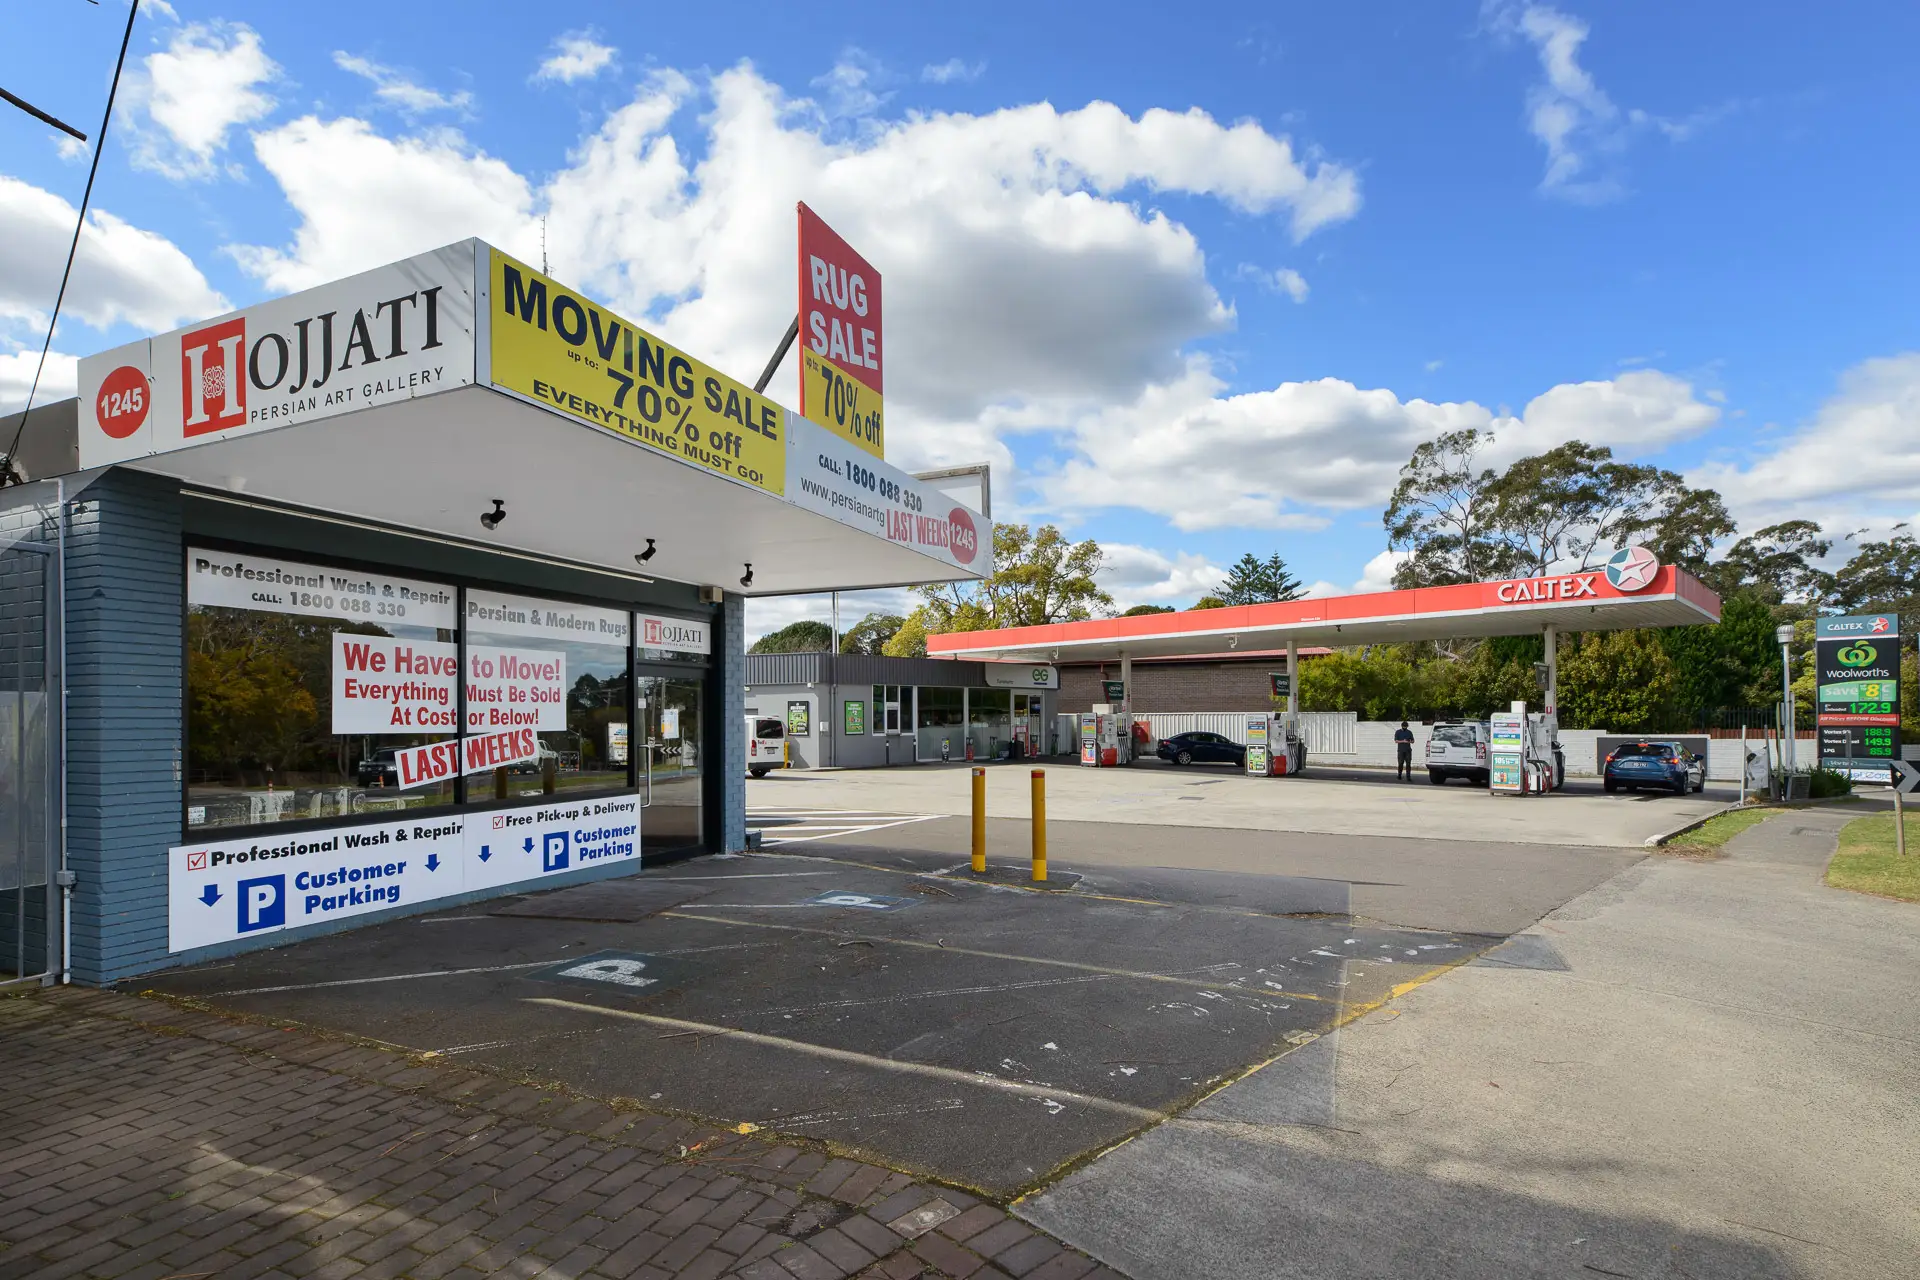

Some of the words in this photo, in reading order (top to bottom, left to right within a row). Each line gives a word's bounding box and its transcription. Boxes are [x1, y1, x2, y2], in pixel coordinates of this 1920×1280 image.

[810, 254, 868, 317] RUG
[185, 286, 442, 427] HOJJATI
[504, 263, 695, 399] MOVING
[704, 377, 777, 441] SALE
[567, 350, 581, 364] up
[584, 356, 599, 370] to:
[810, 310, 878, 371] SALE
[101, 387, 143, 419] 1245
[251, 395, 316, 423] PERSIAN
[325, 388, 353, 406] ART
[362, 367, 444, 398] GALLERY
[607, 368, 700, 441] 70%
[709, 431, 742, 459] off
[821, 365, 862, 437] 70%
[865, 410, 881, 447] off
[533, 379, 678, 450] EVERYTHING
[684, 442, 732, 472] MUST
[737, 465, 764, 484] GO!
[819, 454, 842, 475] CALL:
[846, 460, 876, 492] 1800
[880, 477, 900, 503] 088
[904, 489, 923, 512] 330
[886, 508, 913, 543] LAST
[916, 514, 949, 548] WEEKS
[951, 522, 974, 550] 1245
[195, 557, 324, 589] Professional
[330, 576, 376, 597] Wash
[381, 584, 395, 598] &
[400, 586, 450, 605] Repair
[1497, 576, 1597, 602] CALTEX
[251, 592, 282, 604] CALL:
[290, 591, 334, 609] 1800
[340, 597, 372, 614] 088
[376, 602, 406, 617] 330
[467, 601, 525, 624] Persian
[530, 609, 542, 626] &
[546, 611, 596, 632] Modern
[600, 618, 627, 637] Rugs
[645, 621, 703, 643] HOJJATI
[1827, 622, 1863, 631] CALTEX
[343, 642, 386, 673] We
[394, 646, 457, 676] Have
[472, 654, 493, 679] to
[500, 655, 560, 681] Move!
[344, 678, 449, 705] Everything
[466, 685, 502, 703] Must
[508, 686, 526, 703] Be
[530, 686, 561, 703] Sold
[1825, 686, 1858, 696] save
[1866, 683, 1880, 697] 8
[1850, 702, 1891, 714] 172.9
[390, 706, 411, 725] At
[417, 706, 457, 726] Cost
[468, 712, 484, 726] or
[490, 708, 539, 726] Below!
[400, 742, 458, 785] LAST
[466, 727, 535, 769] WEEKS
[506, 815, 533, 827] Free
[537, 808, 579, 823] Pick-up
[582, 806, 591, 817] &
[594, 802, 635, 815] Delivery
[211, 836, 338, 868] Professional
[344, 827, 391, 849] Wash
[395, 827, 408, 842] &
[413, 822, 464, 842] Repair
[548, 837, 565, 867] P
[574, 824, 637, 844] Customer
[580, 841, 633, 861] Parking
[249, 884, 277, 924] P
[295, 860, 406, 891] Customer
[305, 884, 400, 915] Parking
